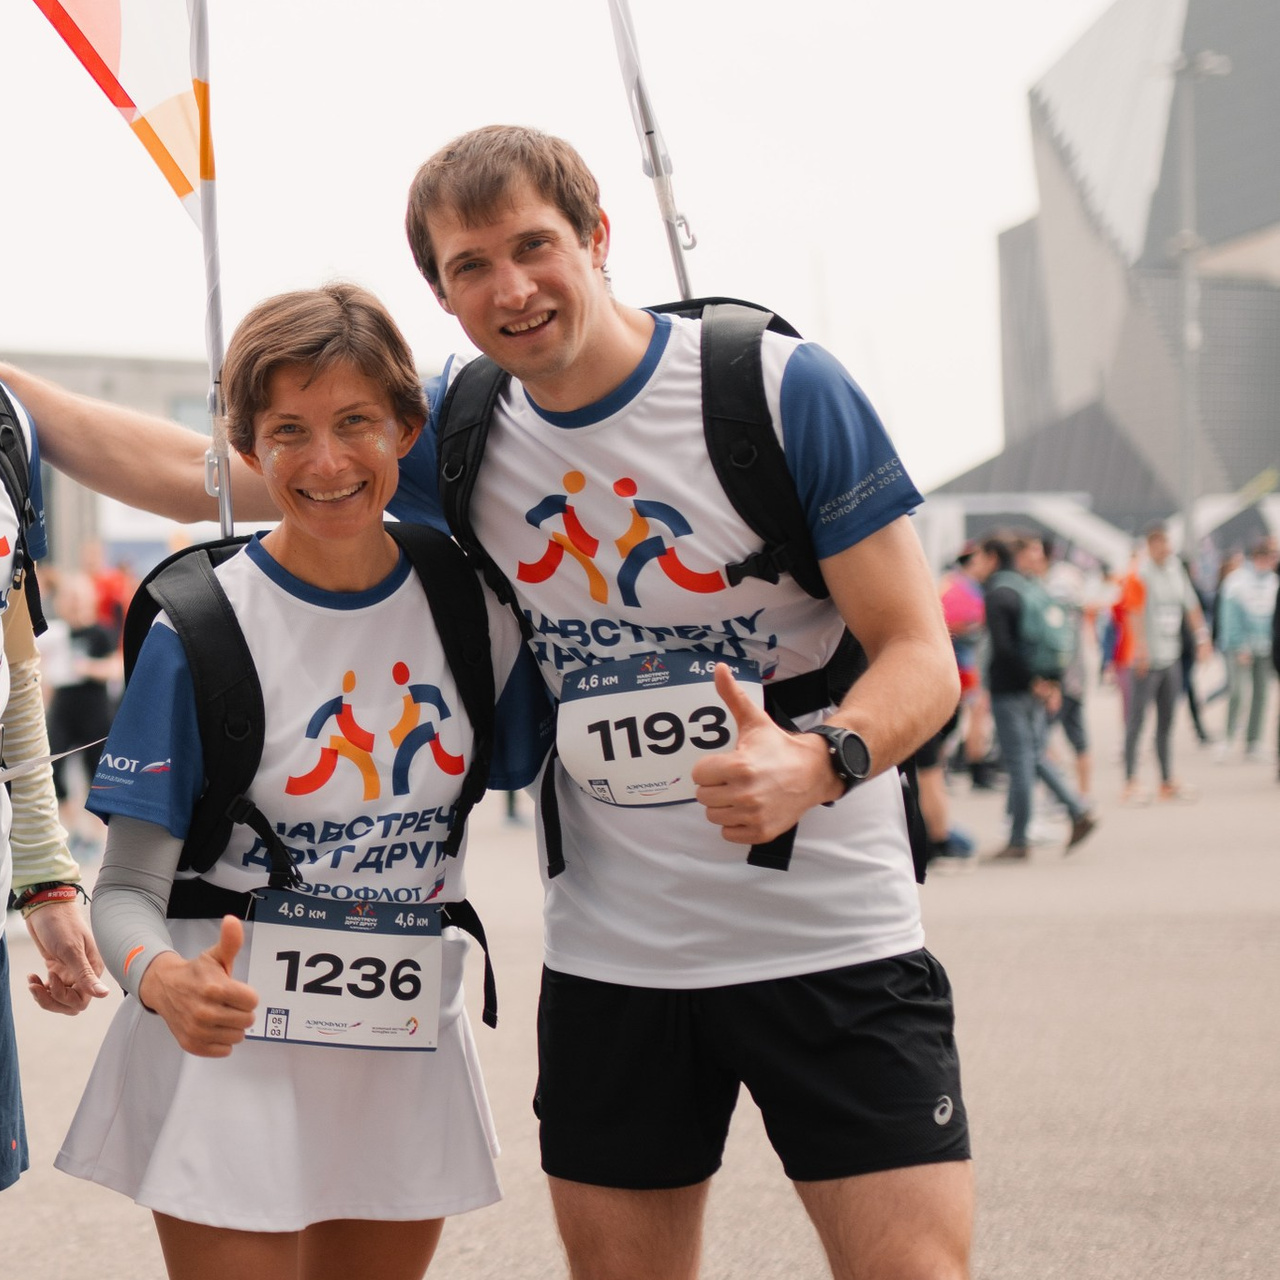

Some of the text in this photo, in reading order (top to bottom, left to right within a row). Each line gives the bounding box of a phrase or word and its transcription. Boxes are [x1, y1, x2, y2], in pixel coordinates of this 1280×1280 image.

[689, 660, 715, 676] 4,6
[577, 674, 599, 691] 4,6
[587, 705, 730, 761] 1193
[278, 902, 305, 918] 4,6
[395, 912, 414, 928] 4,6
[276, 950, 422, 1001] 1236
